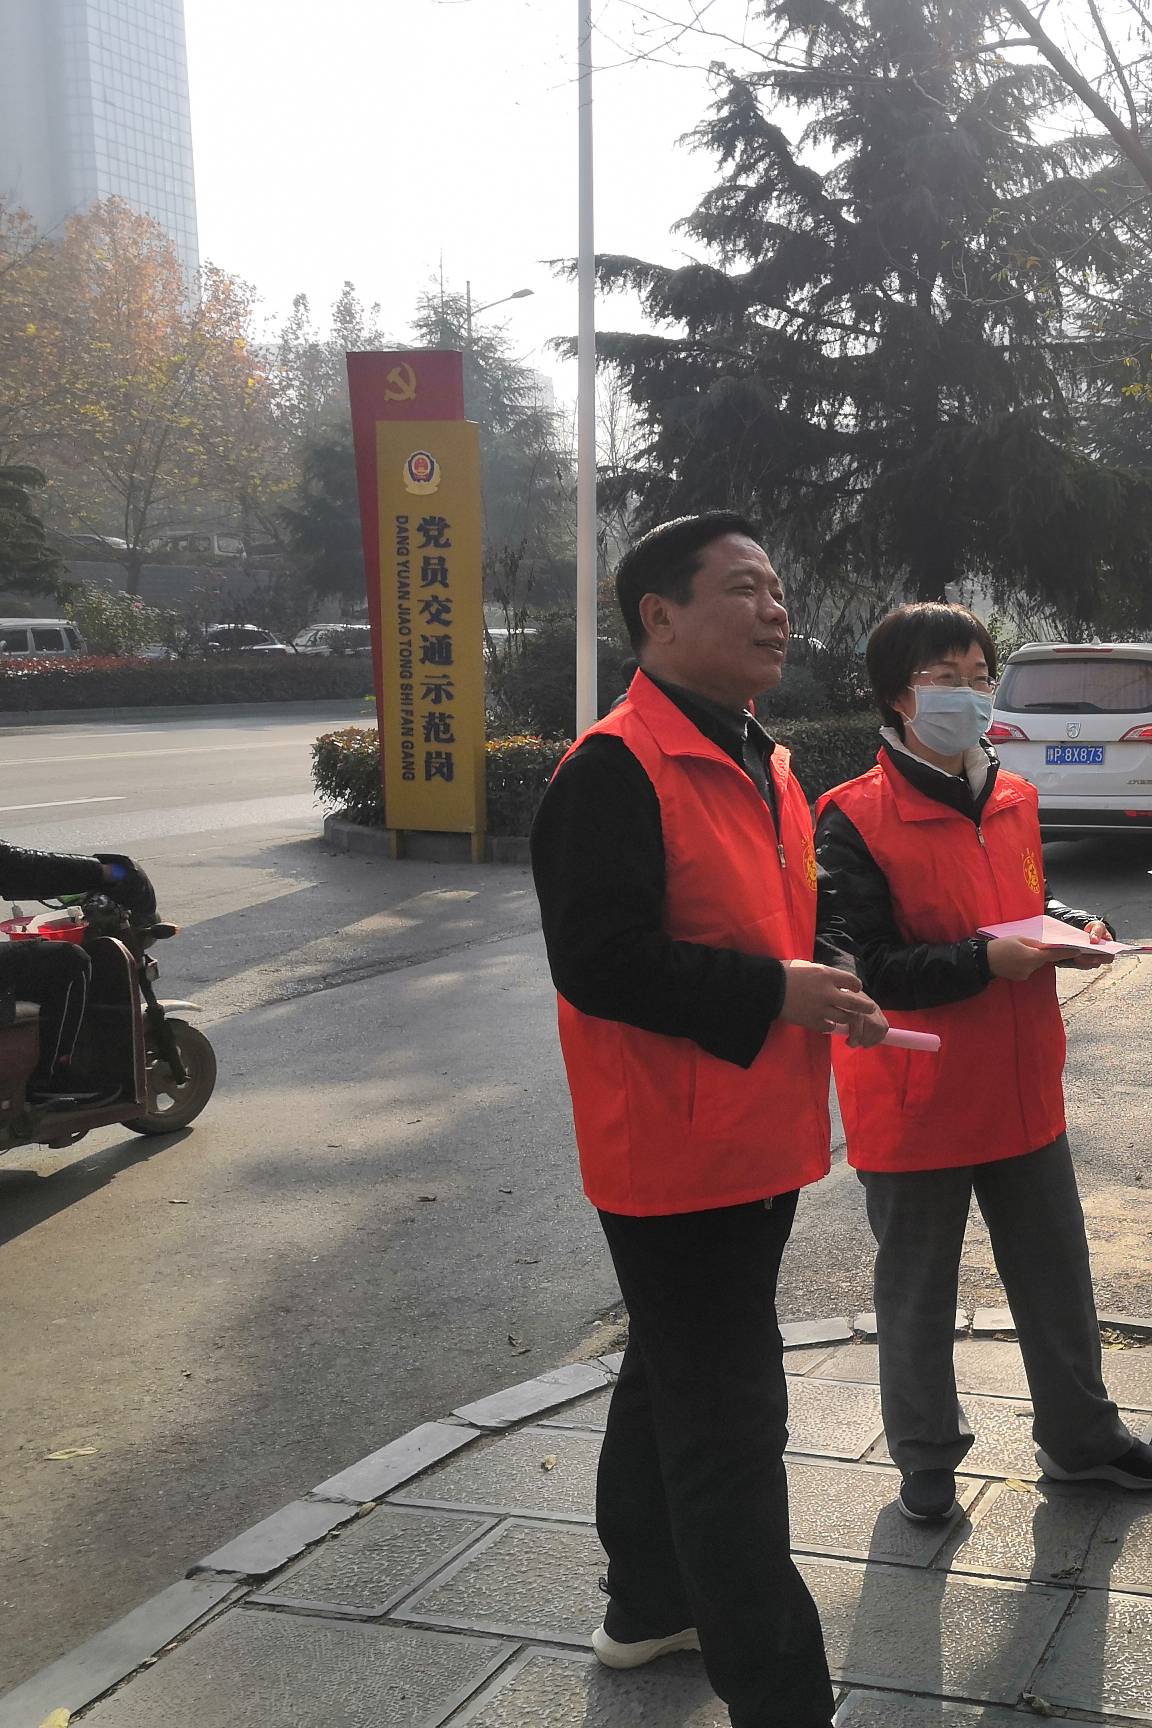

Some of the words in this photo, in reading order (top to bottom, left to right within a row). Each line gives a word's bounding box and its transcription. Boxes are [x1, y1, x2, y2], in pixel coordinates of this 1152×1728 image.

[396, 516, 410, 556] DANG
[397, 560, 411, 600] YUAN
[398, 603, 412, 637] JIAO
[399, 641, 414, 680] TONG
[416, 515, 456, 781] 党员交通示范岗
[400, 683, 414, 706] SHI
[401, 709, 415, 738] FAN
[402, 740, 416, 781] GANG
